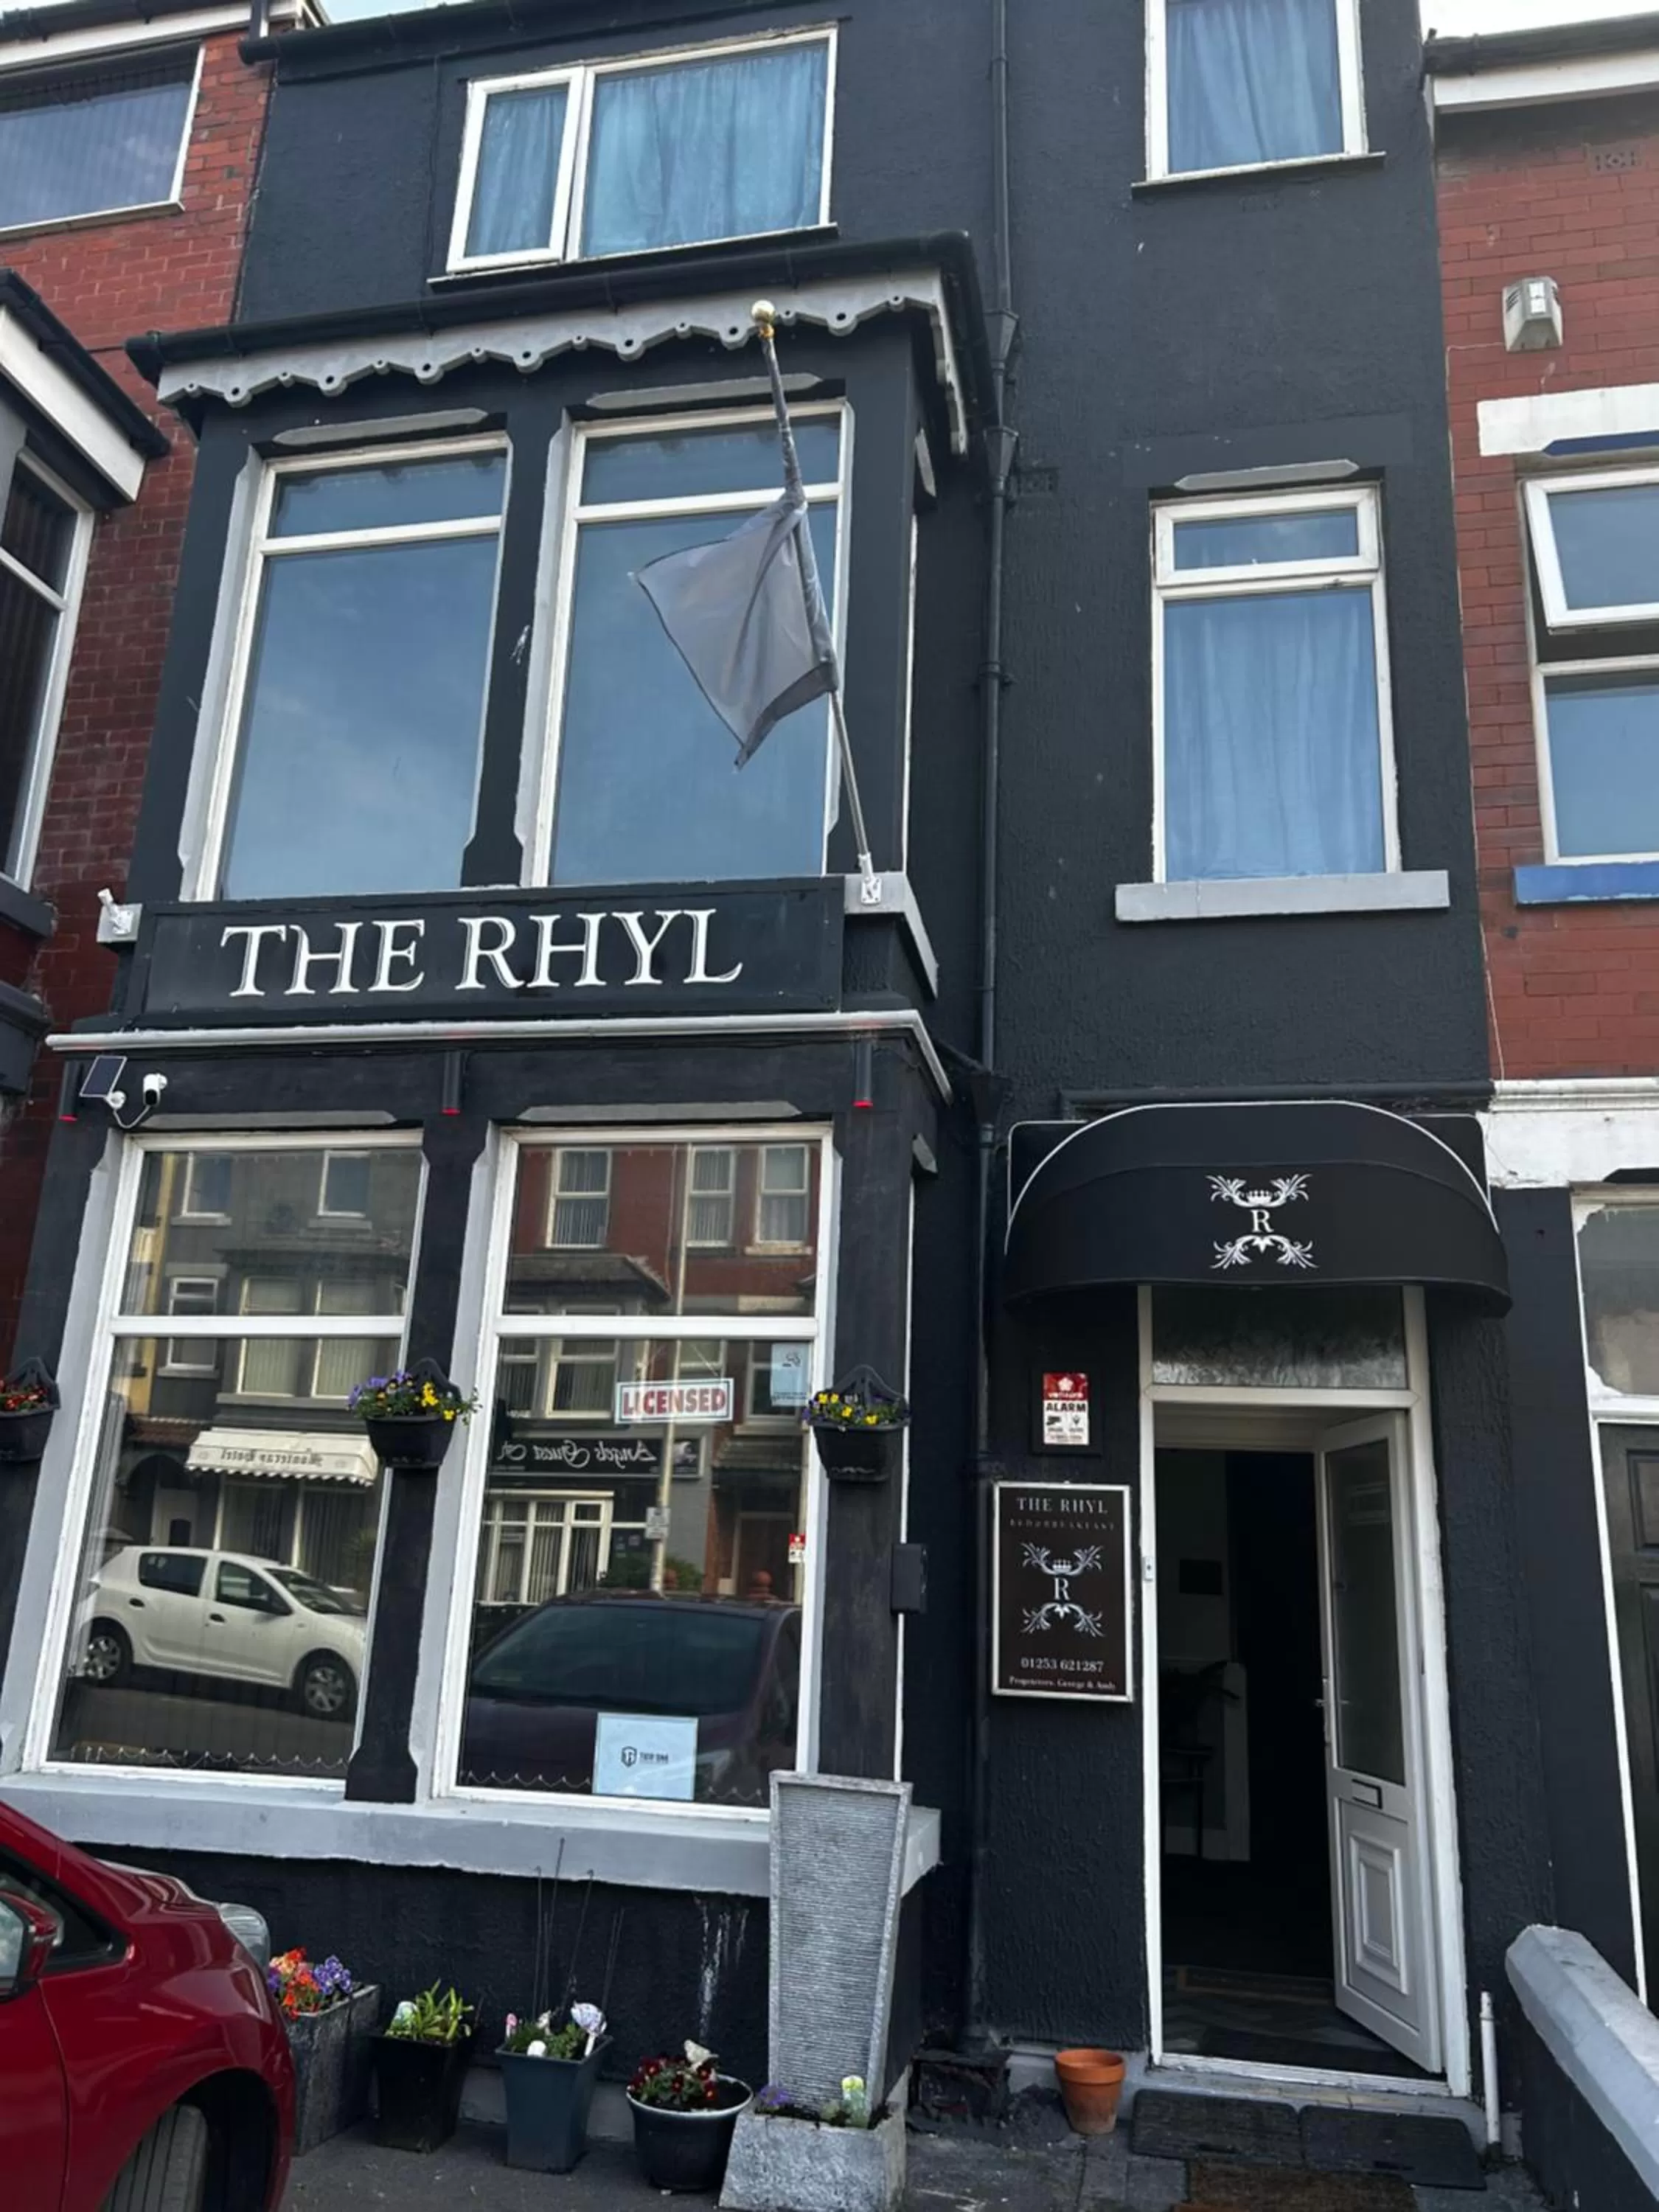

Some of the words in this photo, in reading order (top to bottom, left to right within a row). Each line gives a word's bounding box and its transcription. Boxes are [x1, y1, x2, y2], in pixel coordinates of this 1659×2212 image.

[220, 919, 425, 997] THE
[454, 908, 743, 990] RHYL
[1251, 1209, 1274, 1233] R
[623, 1388, 727, 1417] LICENSED
[1046, 1402, 1086, 1412] ALARM
[1016, 1497, 1053, 1512] THE
[1060, 1498, 1108, 1514] RHYL
[1054, 1577, 1069, 1600] R
[1020, 1657, 1057, 1670] 01253
[1060, 1658, 1105, 1673] 621287
